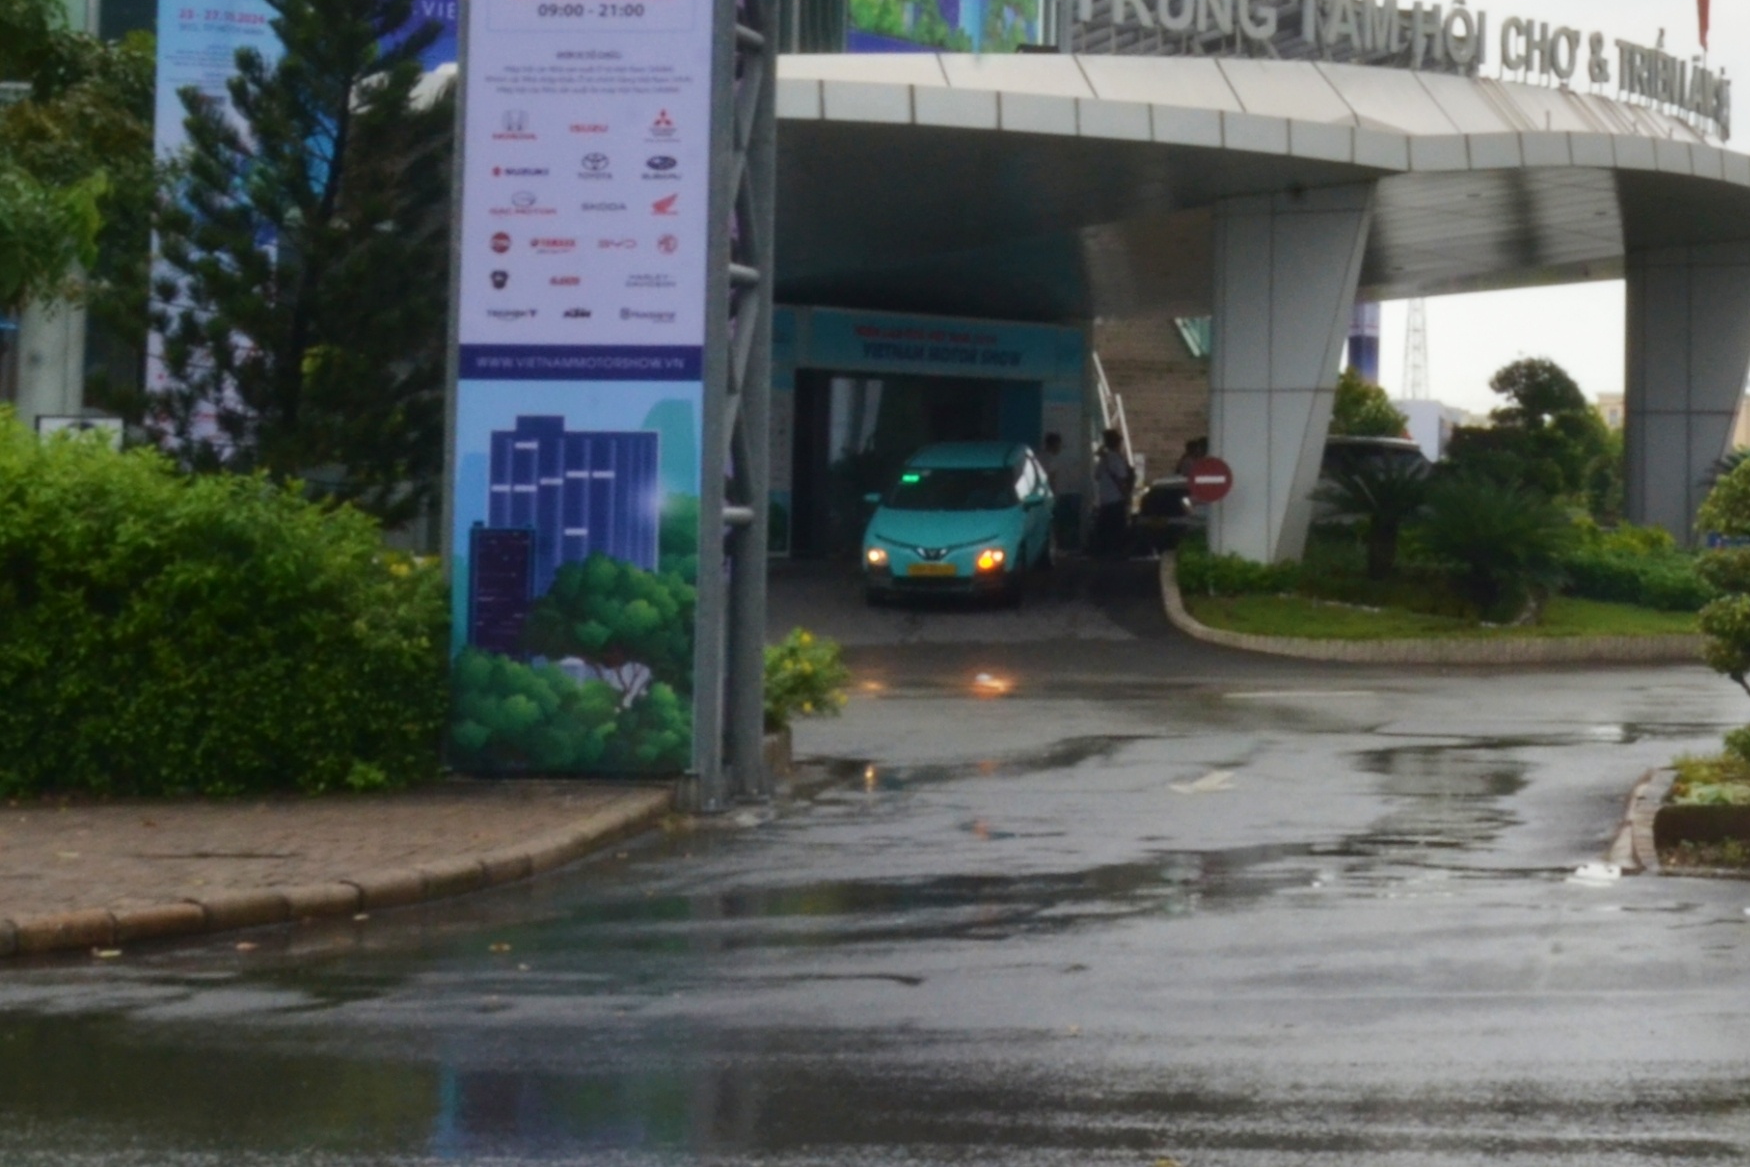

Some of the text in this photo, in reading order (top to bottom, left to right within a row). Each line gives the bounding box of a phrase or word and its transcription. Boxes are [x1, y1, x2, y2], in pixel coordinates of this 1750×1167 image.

[537, 4, 584, 17] 09:00
[598, 4, 645, 17] 21:00
[1501, 16, 1580, 93] CHỢ
[1588, 31, 1609, 83] &
